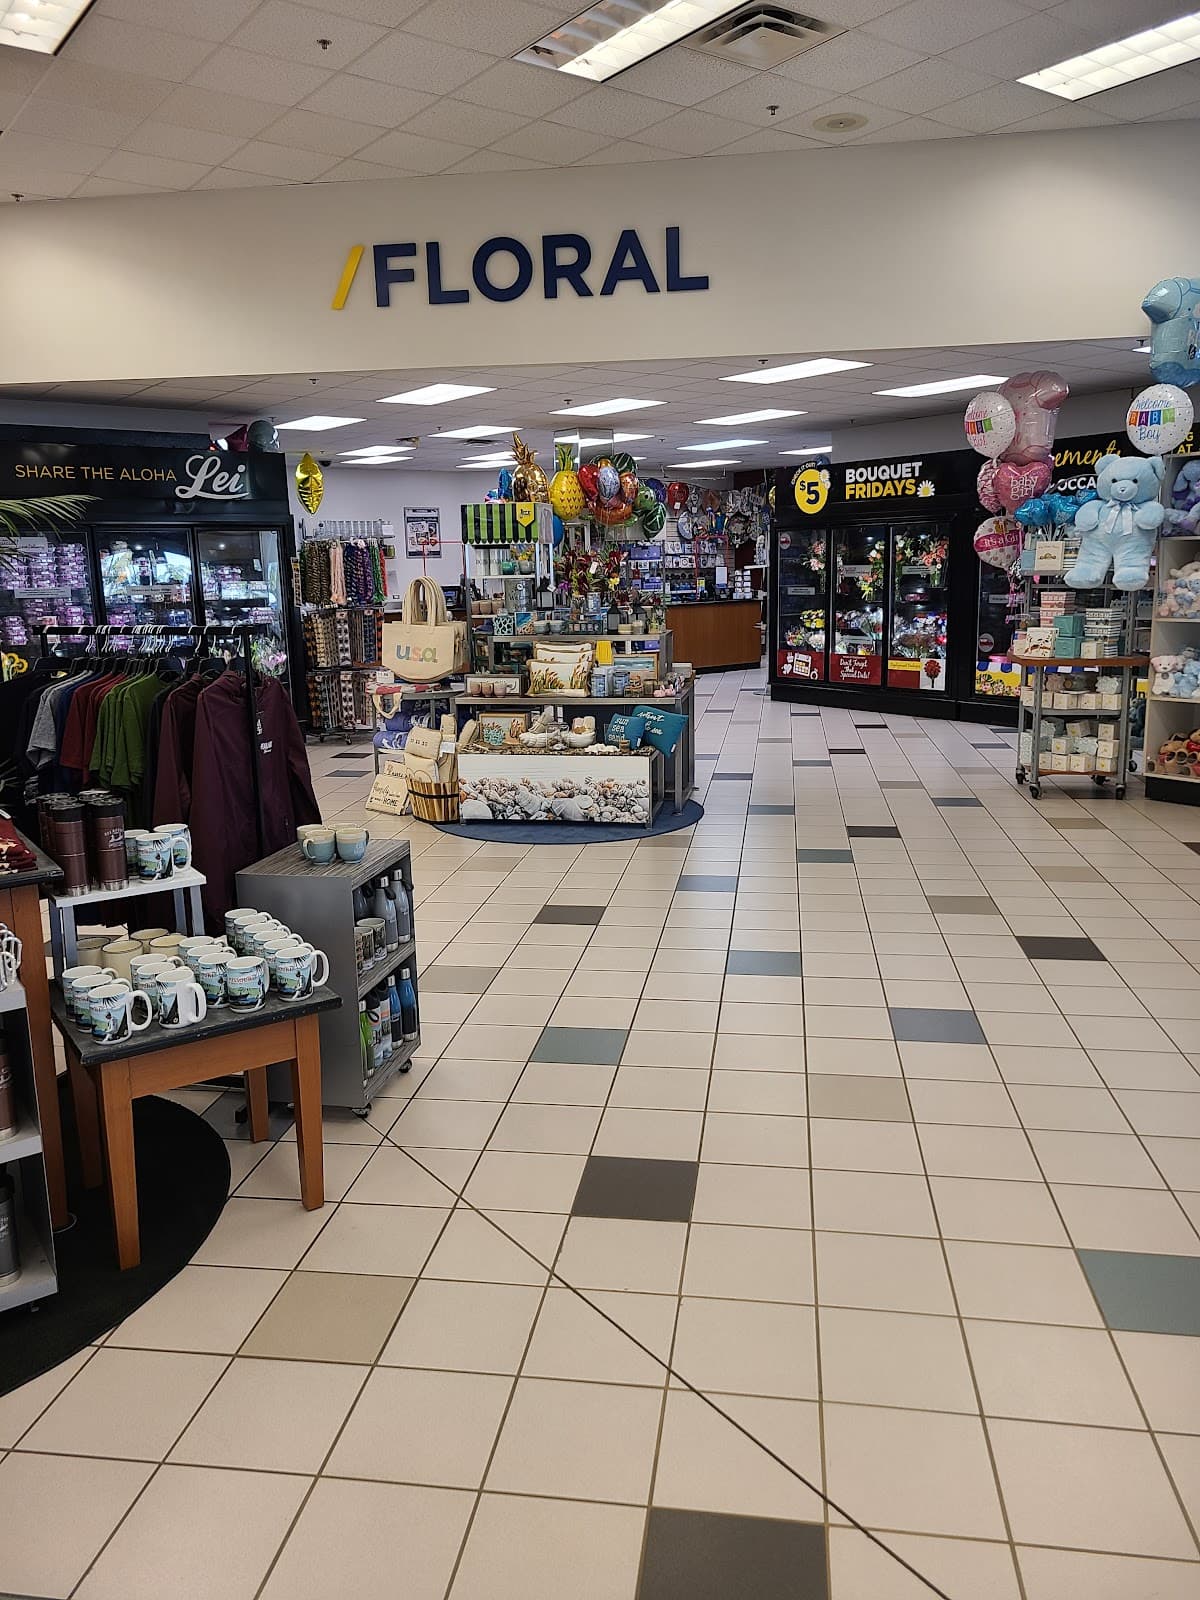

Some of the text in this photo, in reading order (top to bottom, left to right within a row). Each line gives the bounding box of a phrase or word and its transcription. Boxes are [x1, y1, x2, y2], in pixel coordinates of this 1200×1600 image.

[1138, 426, 1160, 443] Boy
[15, 464, 177, 482] SHARE THE ALOHA
[175, 454, 250, 500] Lei
[845, 461, 922, 484] BOUQUET
[1009, 474, 1038, 488] baby
[1057, 477, 1098, 492] OCCA
[845, 479, 916, 500] FRIDAYS
[1010, 486, 1034, 501] girl
[611, 725, 625, 733] sea
[614, 717, 629, 725] sun
